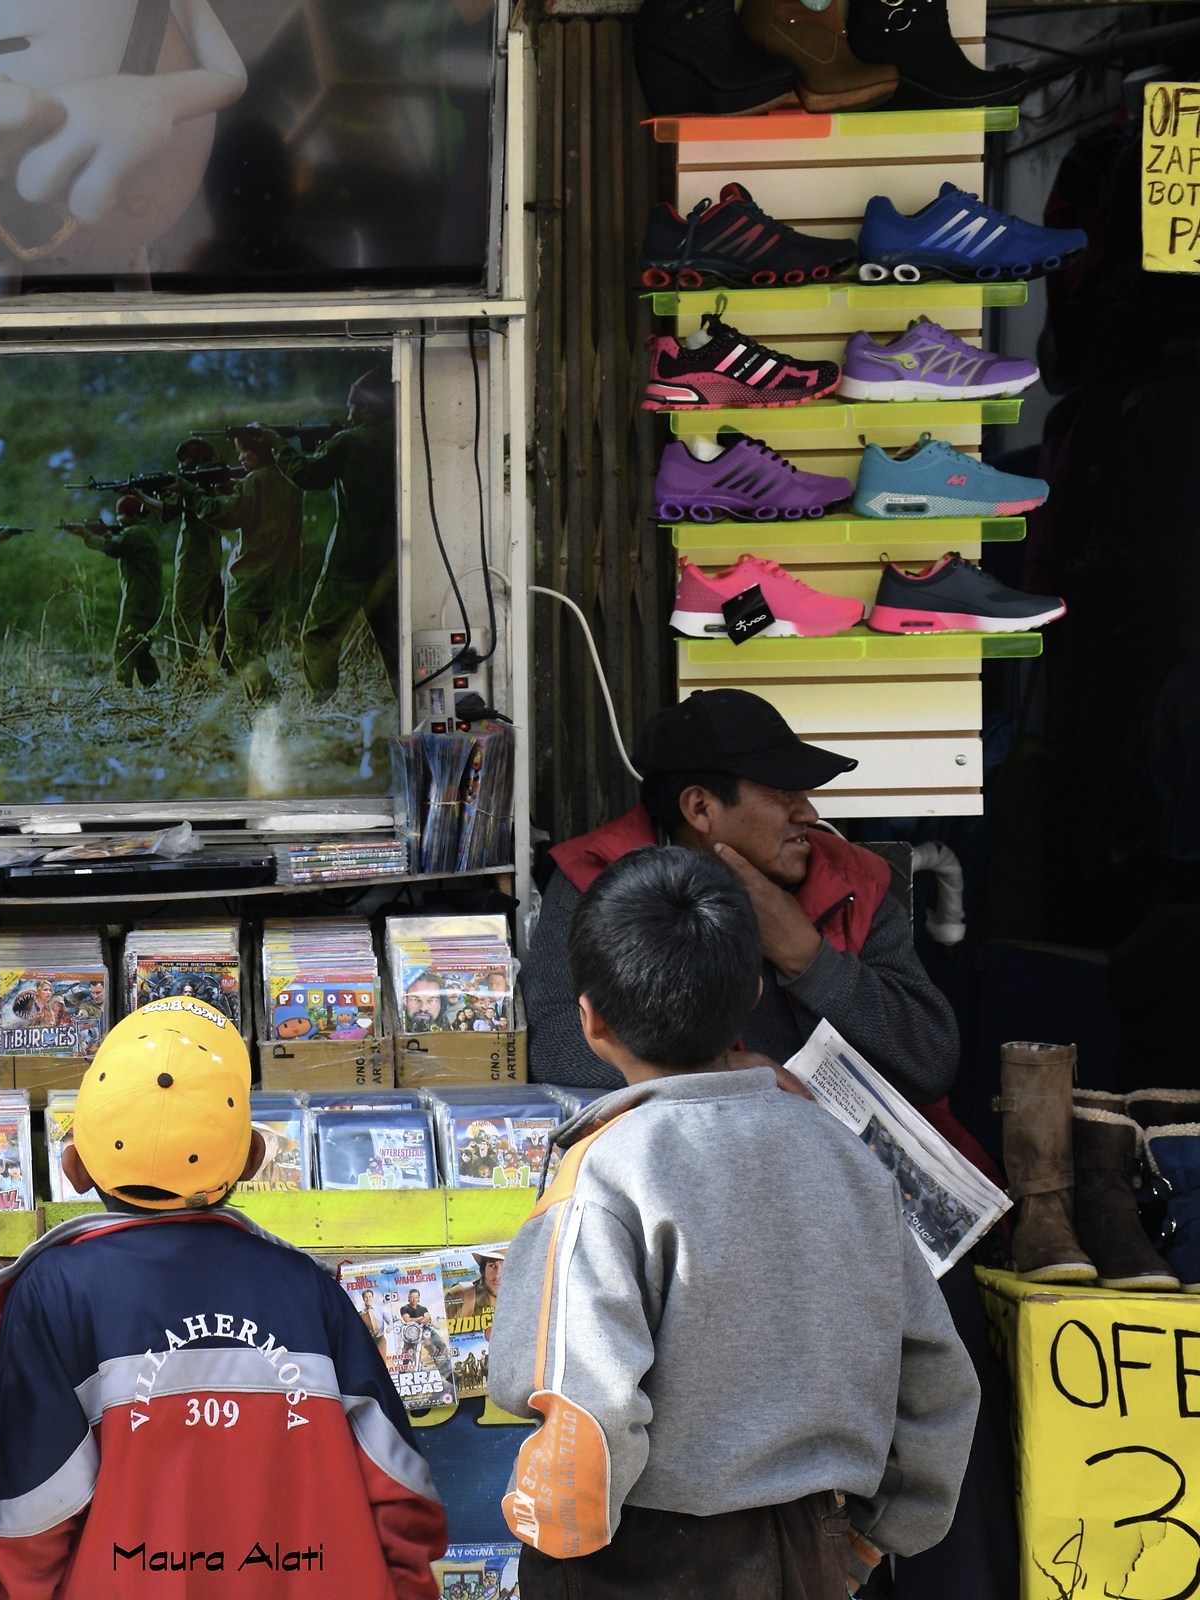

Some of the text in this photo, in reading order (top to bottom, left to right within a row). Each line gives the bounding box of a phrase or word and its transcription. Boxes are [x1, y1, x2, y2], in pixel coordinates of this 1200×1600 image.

[1150, 87, 1200, 138] OF
[279, 993, 370, 1005] POCOYO
[273, 1044, 294, 1059] P
[406, 1038, 429, 1053] P
[832, 1095, 861, 1124] Nacional
[379, 1148, 425, 1158] INTERESTELAR
[393, 1272, 437, 1286] WAHLBERG
[406, 1268, 423, 1277] MARK
[346, 1279, 379, 1292] FERRELL
[482, 1304, 495, 1314] LOS
[448, 1313, 495, 1336] RIDIC
[129, 1312, 310, 1432] VILLAHERMOSA
[184, 1398, 240, 1428] 309
[558, 1410, 578, 1489] UTILITY
[1084, 1444, 1200, 1600] 3
[464, 1547, 495, 1557] OCTAVA
[496, 1546, 522, 1557] TEMP
